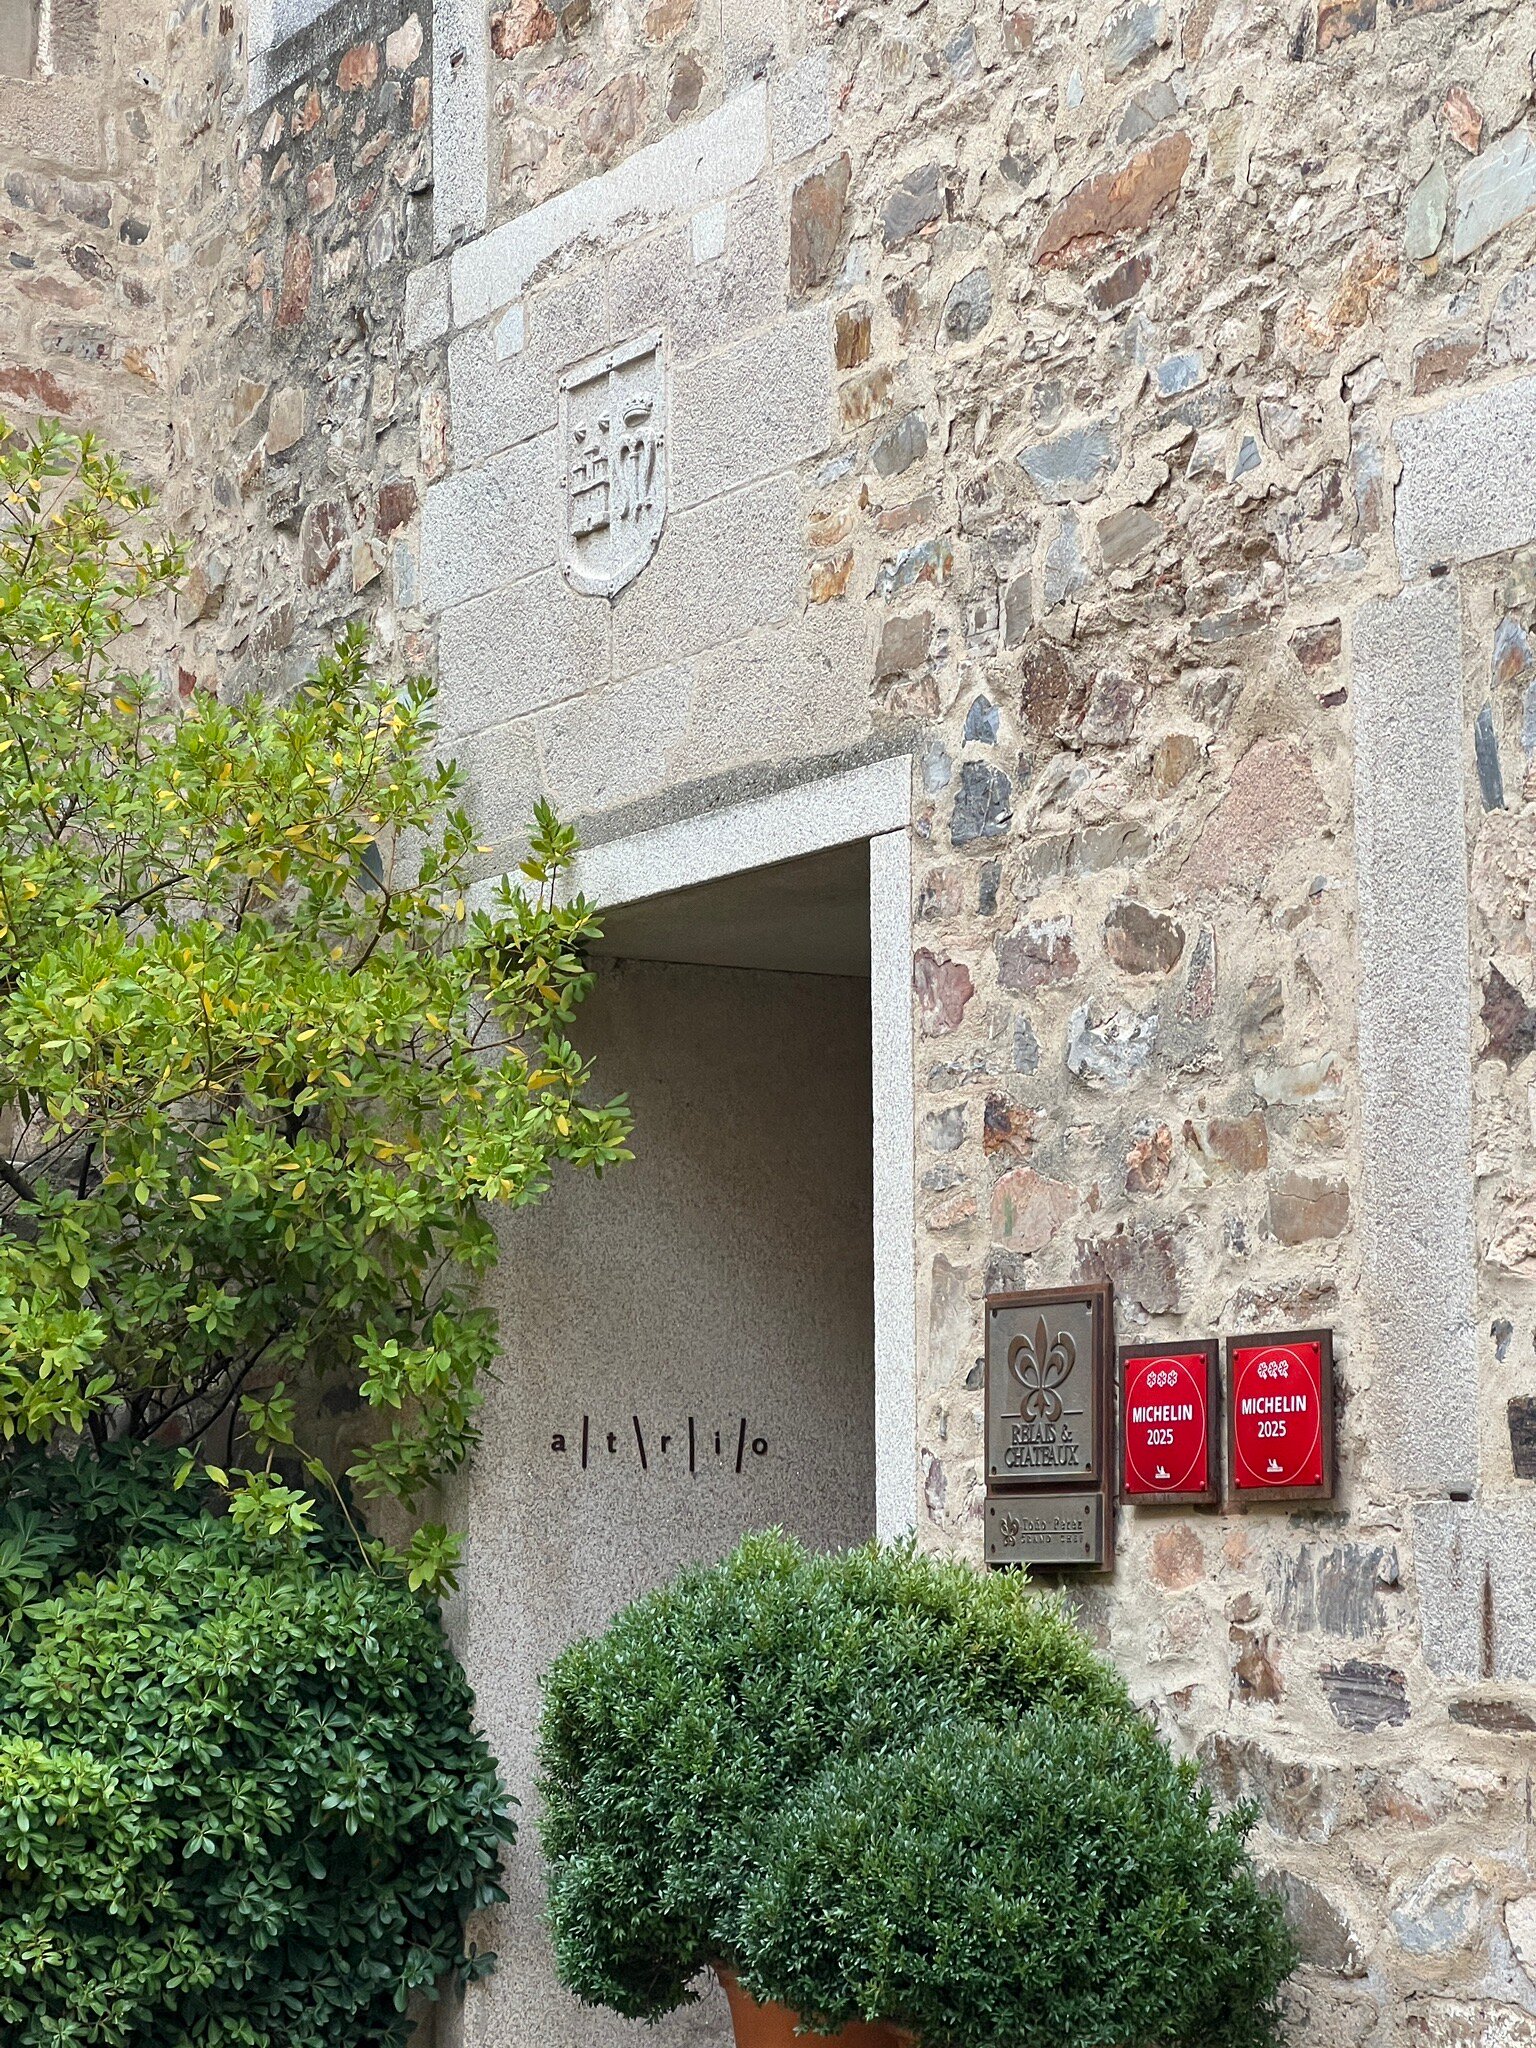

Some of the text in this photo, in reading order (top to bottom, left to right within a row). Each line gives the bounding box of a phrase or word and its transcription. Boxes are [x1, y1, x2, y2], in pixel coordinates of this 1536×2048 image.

[1132, 1404, 1193, 1423] MICHELIN
[1241, 1395, 1307, 1415] MICHELIN
[1012, 1423, 1073, 1445] RELAIS &
[1146, 1428, 1174, 1445] 2025
[1257, 1420, 1287, 1438] 2025
